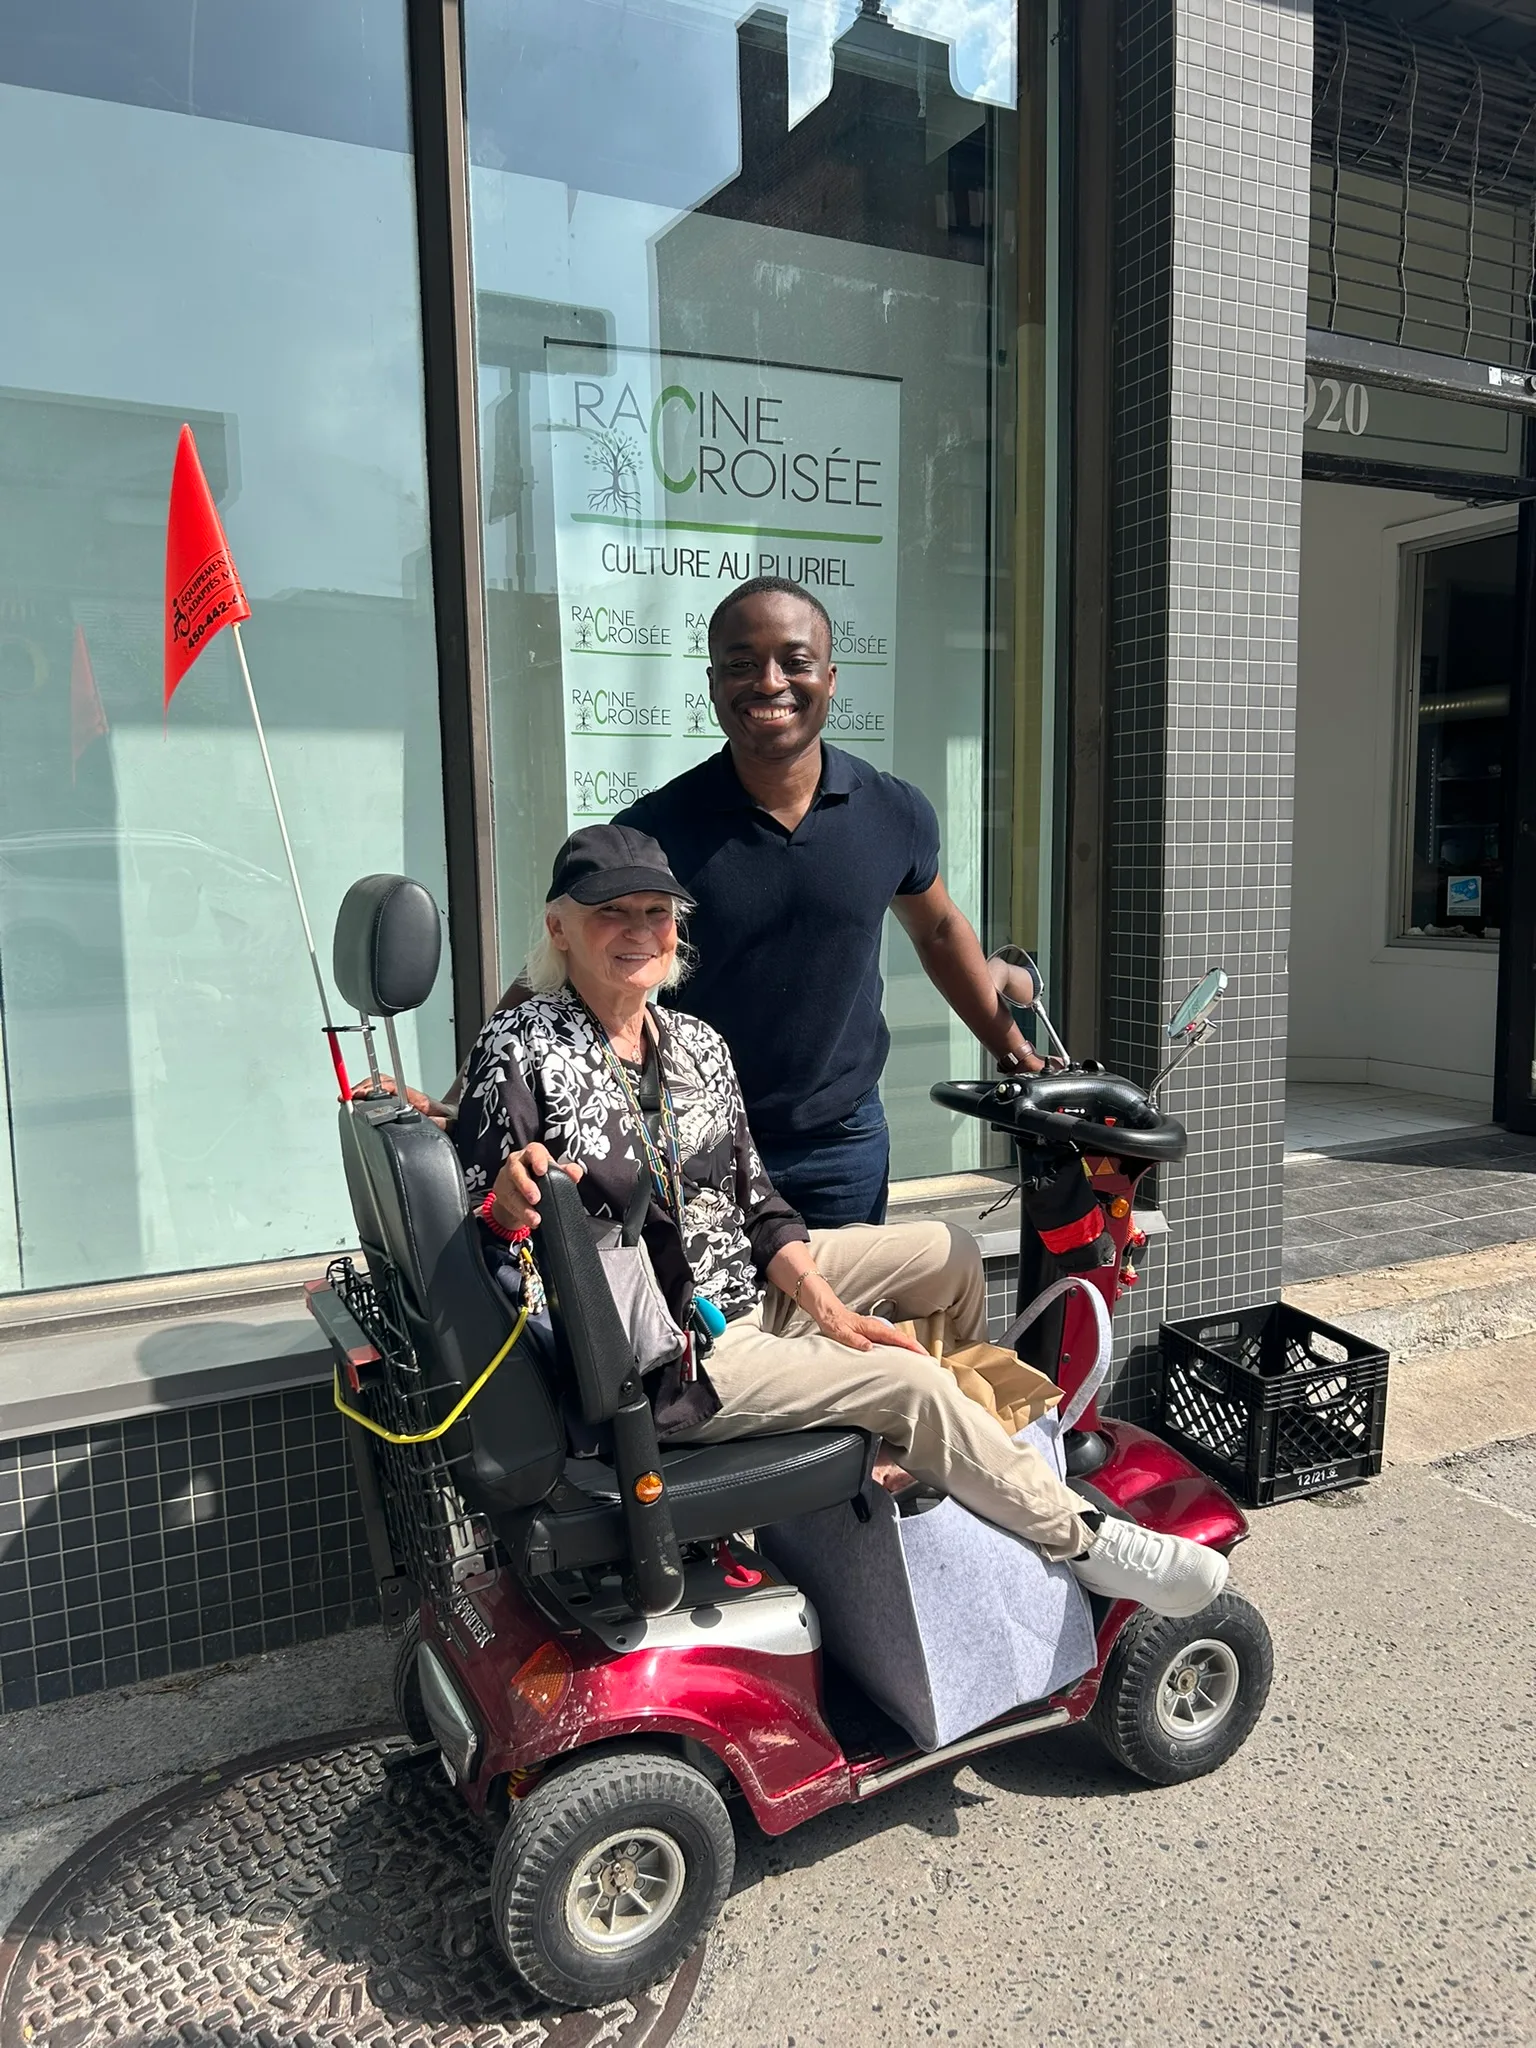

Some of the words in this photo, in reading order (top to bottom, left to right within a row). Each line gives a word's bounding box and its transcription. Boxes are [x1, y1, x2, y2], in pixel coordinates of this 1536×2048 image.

[574, 381, 784, 494] RACINE
[601, 543, 710, 578] CULTURE
[717, 552, 750, 580] AU
[571, 605, 636, 643] RACINE
[831, 635, 888, 654] ROISÉE
[572, 689, 636, 725] RACINE
[827, 711, 885, 730] ROISÉE
[574, 770, 638, 805] RACINE
[1297, 1470, 1325, 1486] 12/21
